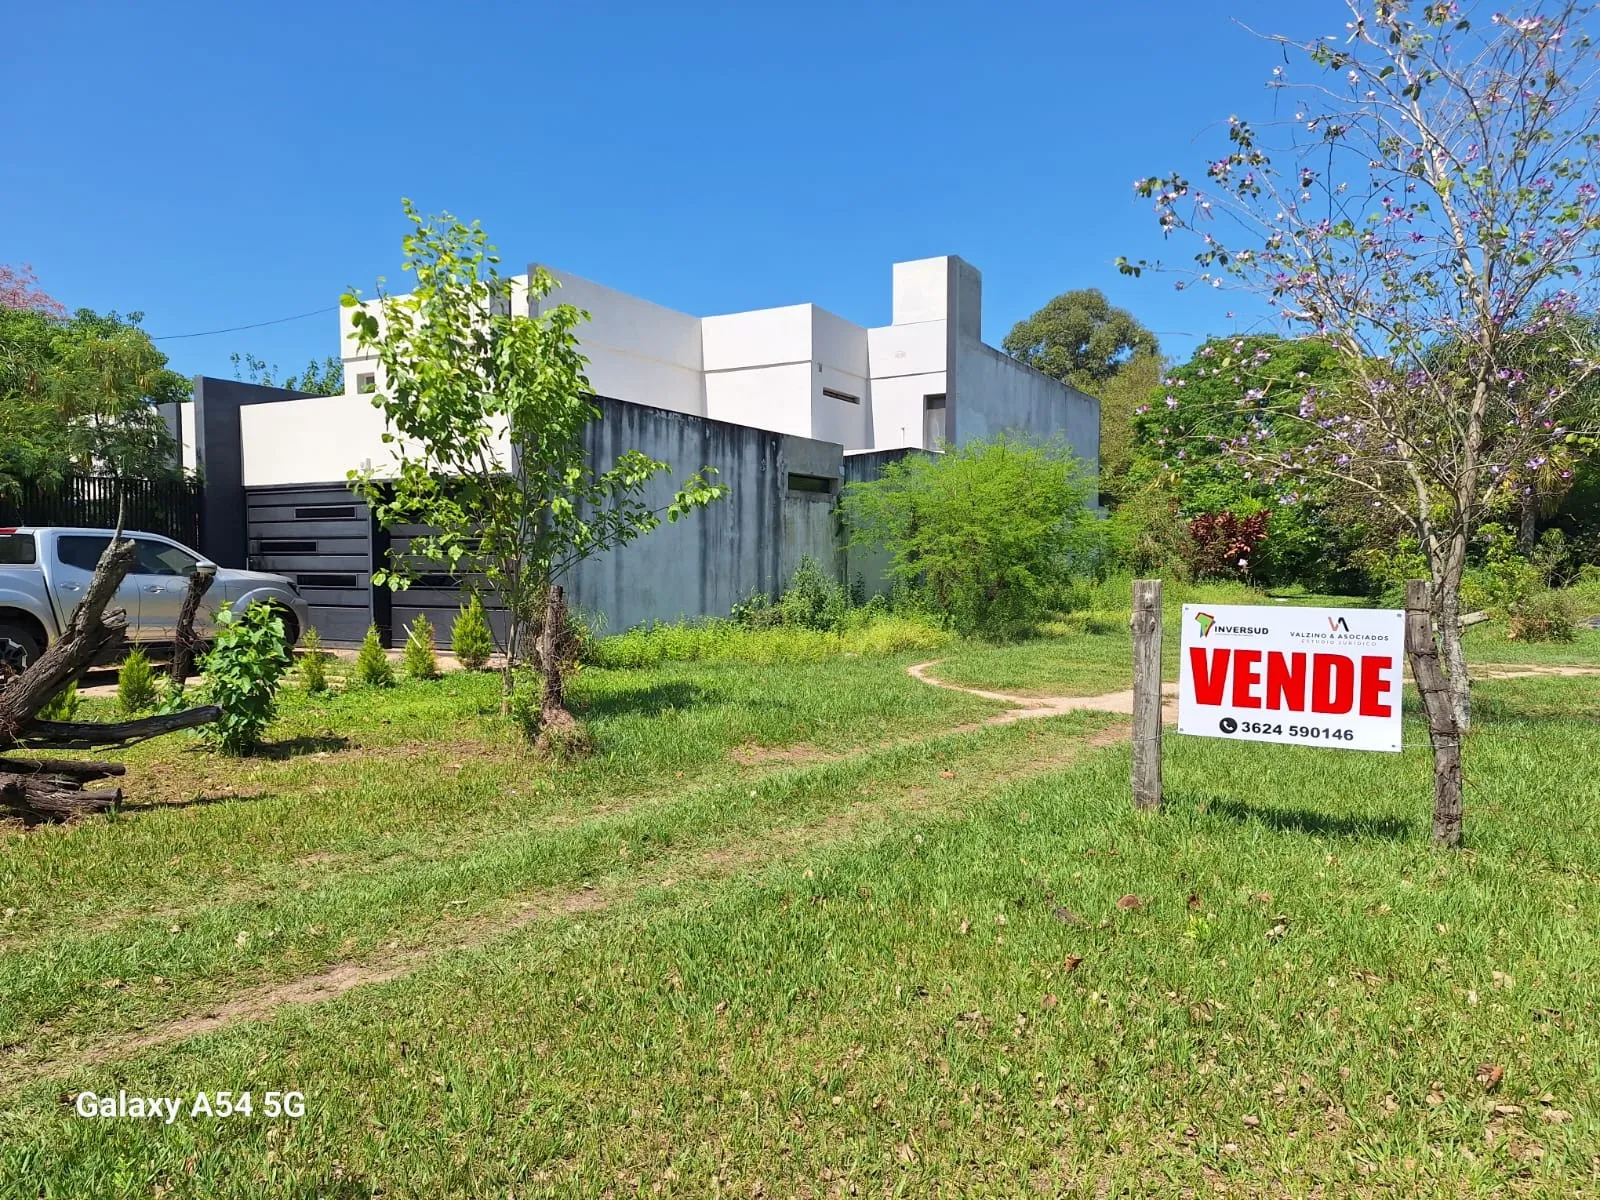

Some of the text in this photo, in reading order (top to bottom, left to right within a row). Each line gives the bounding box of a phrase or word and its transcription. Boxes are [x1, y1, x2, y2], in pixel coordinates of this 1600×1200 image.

[1214, 625, 1269, 634] INVERSUD
[1290, 631, 1327, 639] VALZINO
[1189, 647, 1393, 717] VENDE
[1241, 721, 1354, 741] 3624 590146
